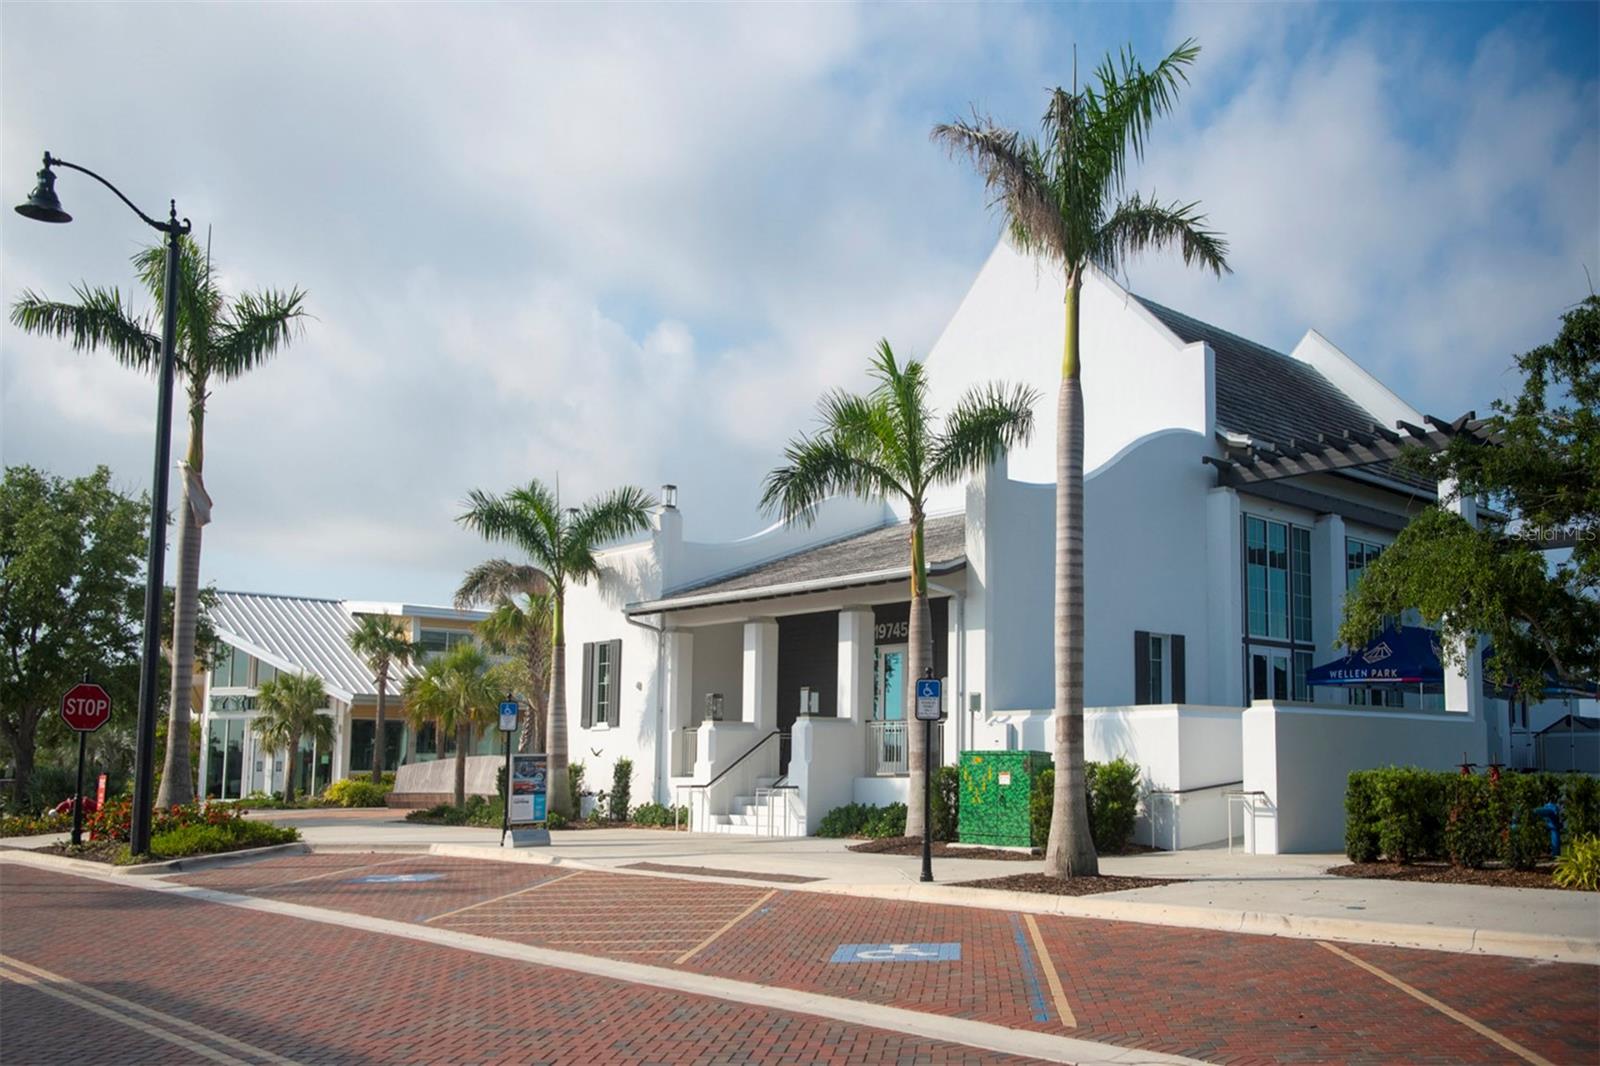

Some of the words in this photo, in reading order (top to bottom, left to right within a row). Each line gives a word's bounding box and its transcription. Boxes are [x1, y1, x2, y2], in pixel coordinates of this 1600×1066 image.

[875, 621, 908, 640] 19745
[1329, 669, 1368, 678] WELLEN
[1371, 668, 1398, 677] PARK
[65, 698, 107, 716] STOP
